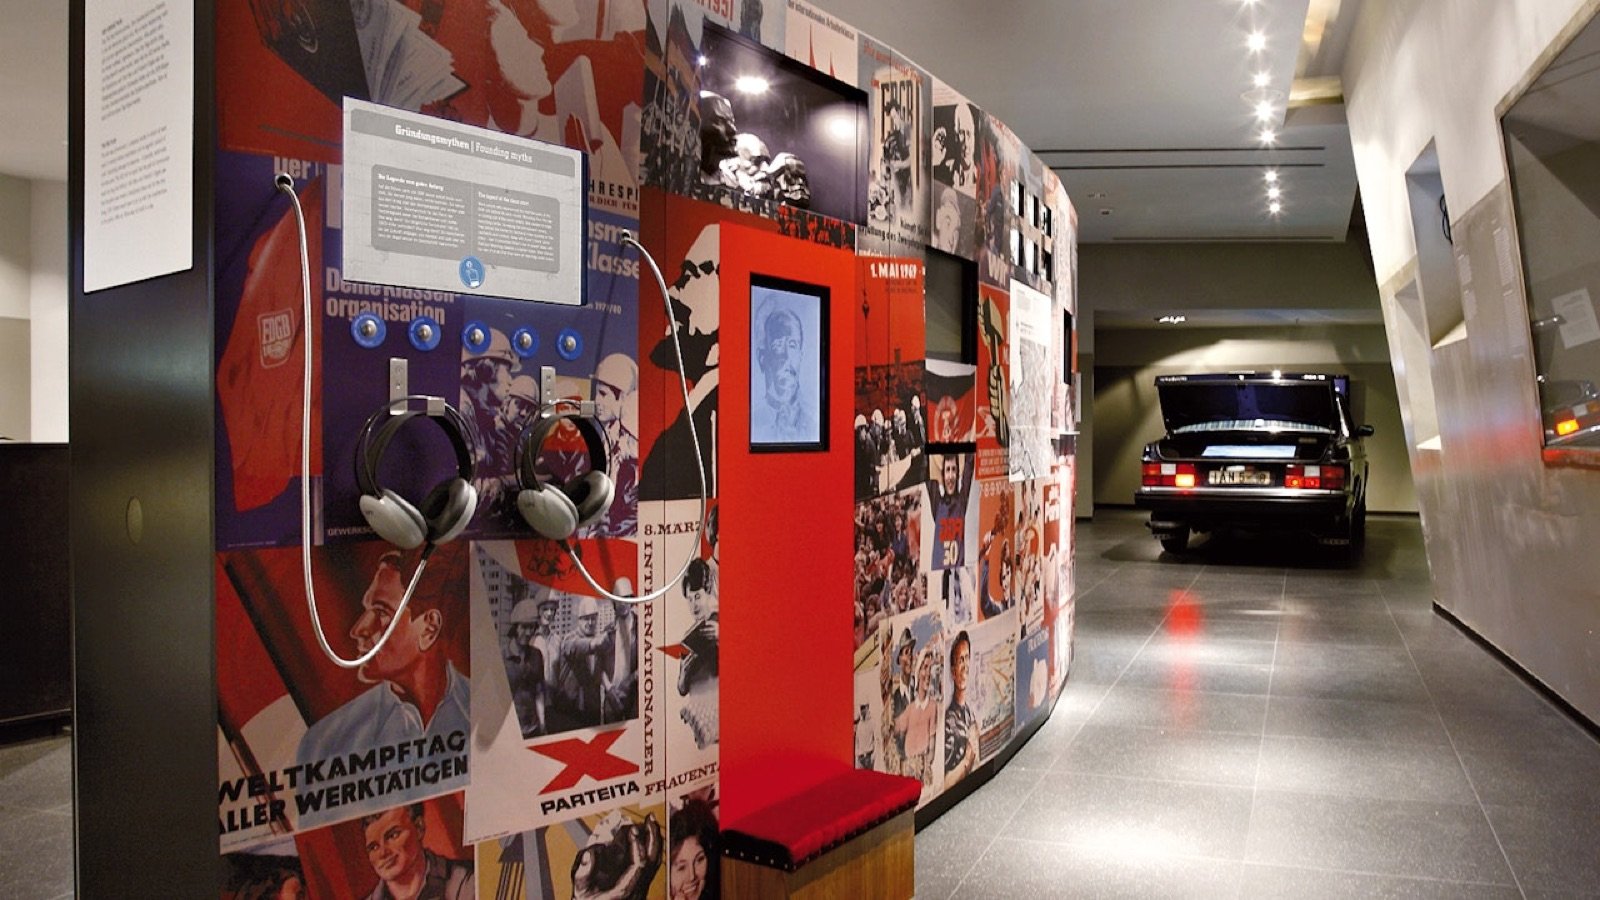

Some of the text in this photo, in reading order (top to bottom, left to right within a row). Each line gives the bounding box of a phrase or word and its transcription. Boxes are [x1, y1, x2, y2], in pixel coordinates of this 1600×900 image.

[395, 124, 533, 164] Gründungsmythen Founding myths
[588, 240, 639, 280] lasse
[327, 296, 446, 325] organisation
[644, 540, 654, 777] INTERNATIONALER
[218, 730, 466, 805] WELTKAMPFTAG
[296, 755, 468, 816] WERKTÄTIGEN
[644, 762, 720, 797] FRAUENT
[540, 780, 640, 815] PARTEITA
